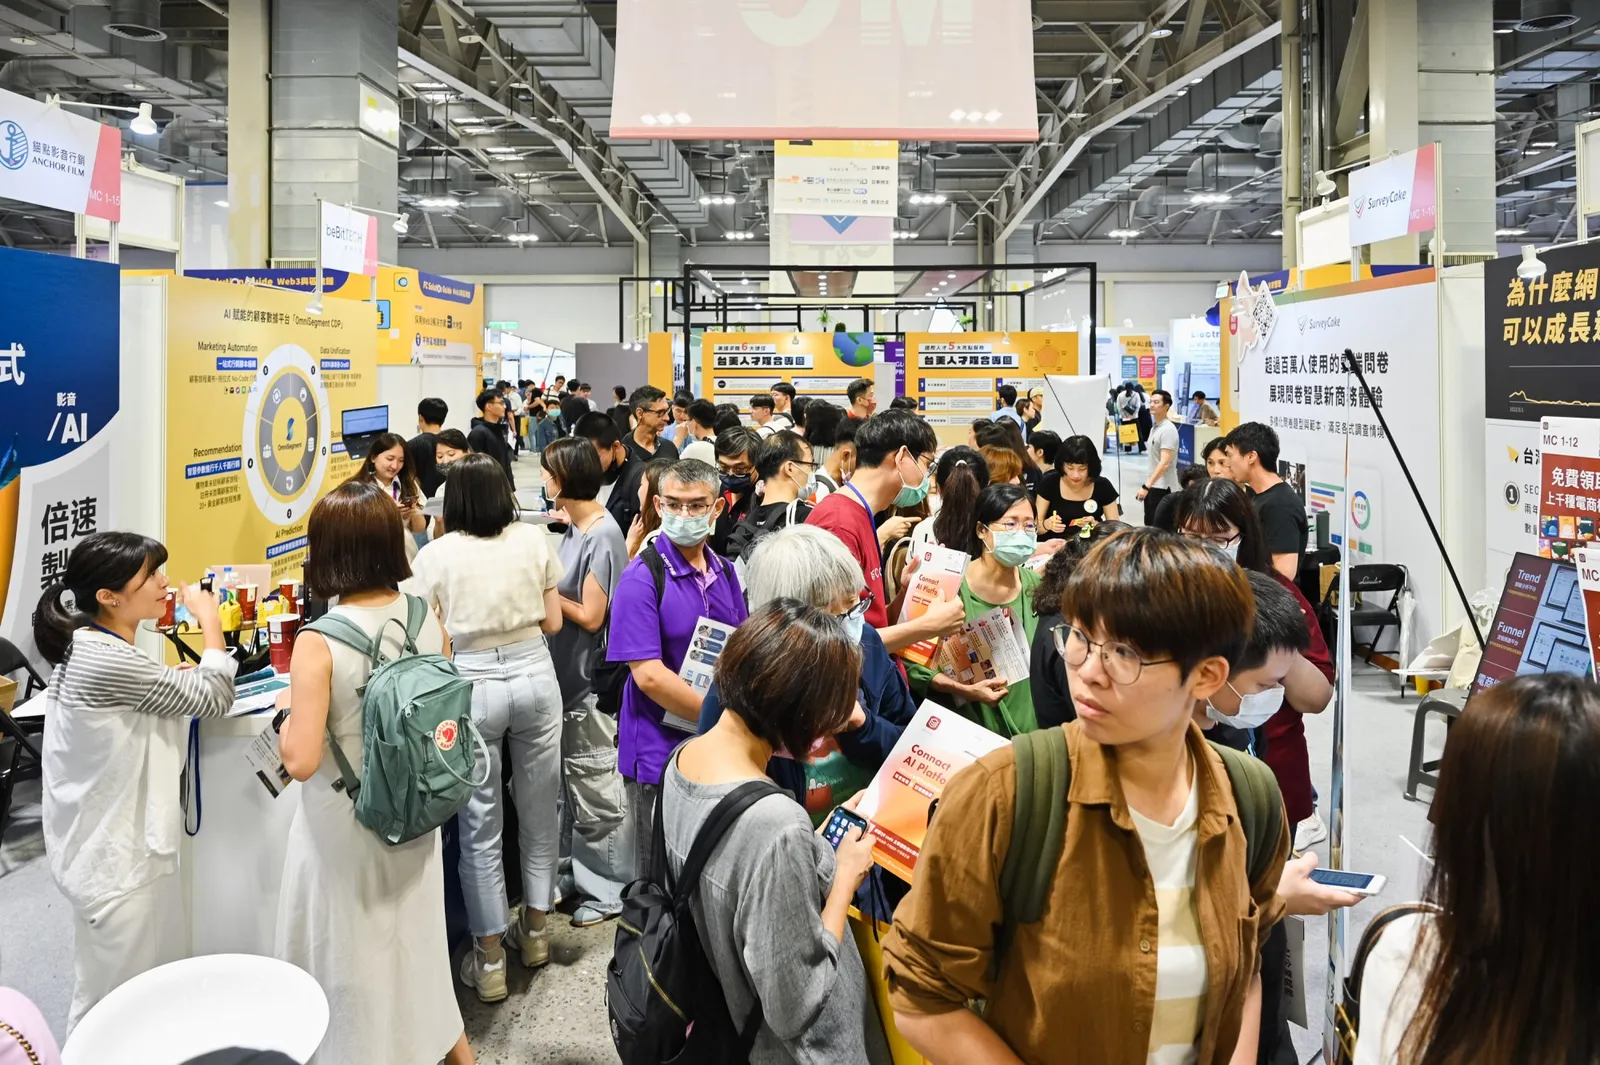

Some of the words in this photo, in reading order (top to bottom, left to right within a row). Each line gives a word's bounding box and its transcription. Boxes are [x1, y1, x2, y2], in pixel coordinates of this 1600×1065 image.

[32, 156, 66, 172] ANCHOR
[67, 165, 85, 177] FILM
[89, 189, 103, 201] MC
[1368, 190, 1407, 210] SurveyCake
[223, 309, 232, 319] AI
[1309, 317, 1341, 331] SurveyCake
[198, 341, 227, 354] Marketing
[227, 342, 258, 353] Automation
[56, 391, 77, 407] 影音
[1543, 434, 1558, 446] MC
[1561, 436, 1578, 448] 1-12
[193, 443, 242, 457] Recommendation
[1545, 491, 1600, 513] 上千種電商
[41, 496, 98, 546] 倍速
[281, 524, 303, 538] Prediction
[1518, 569, 1542, 584] Trend
[1582, 568, 1600, 581] MC
[1497, 621, 1526, 639] Funnel
[902, 755, 917, 768] AI
[911, 744, 952, 771] Connact
